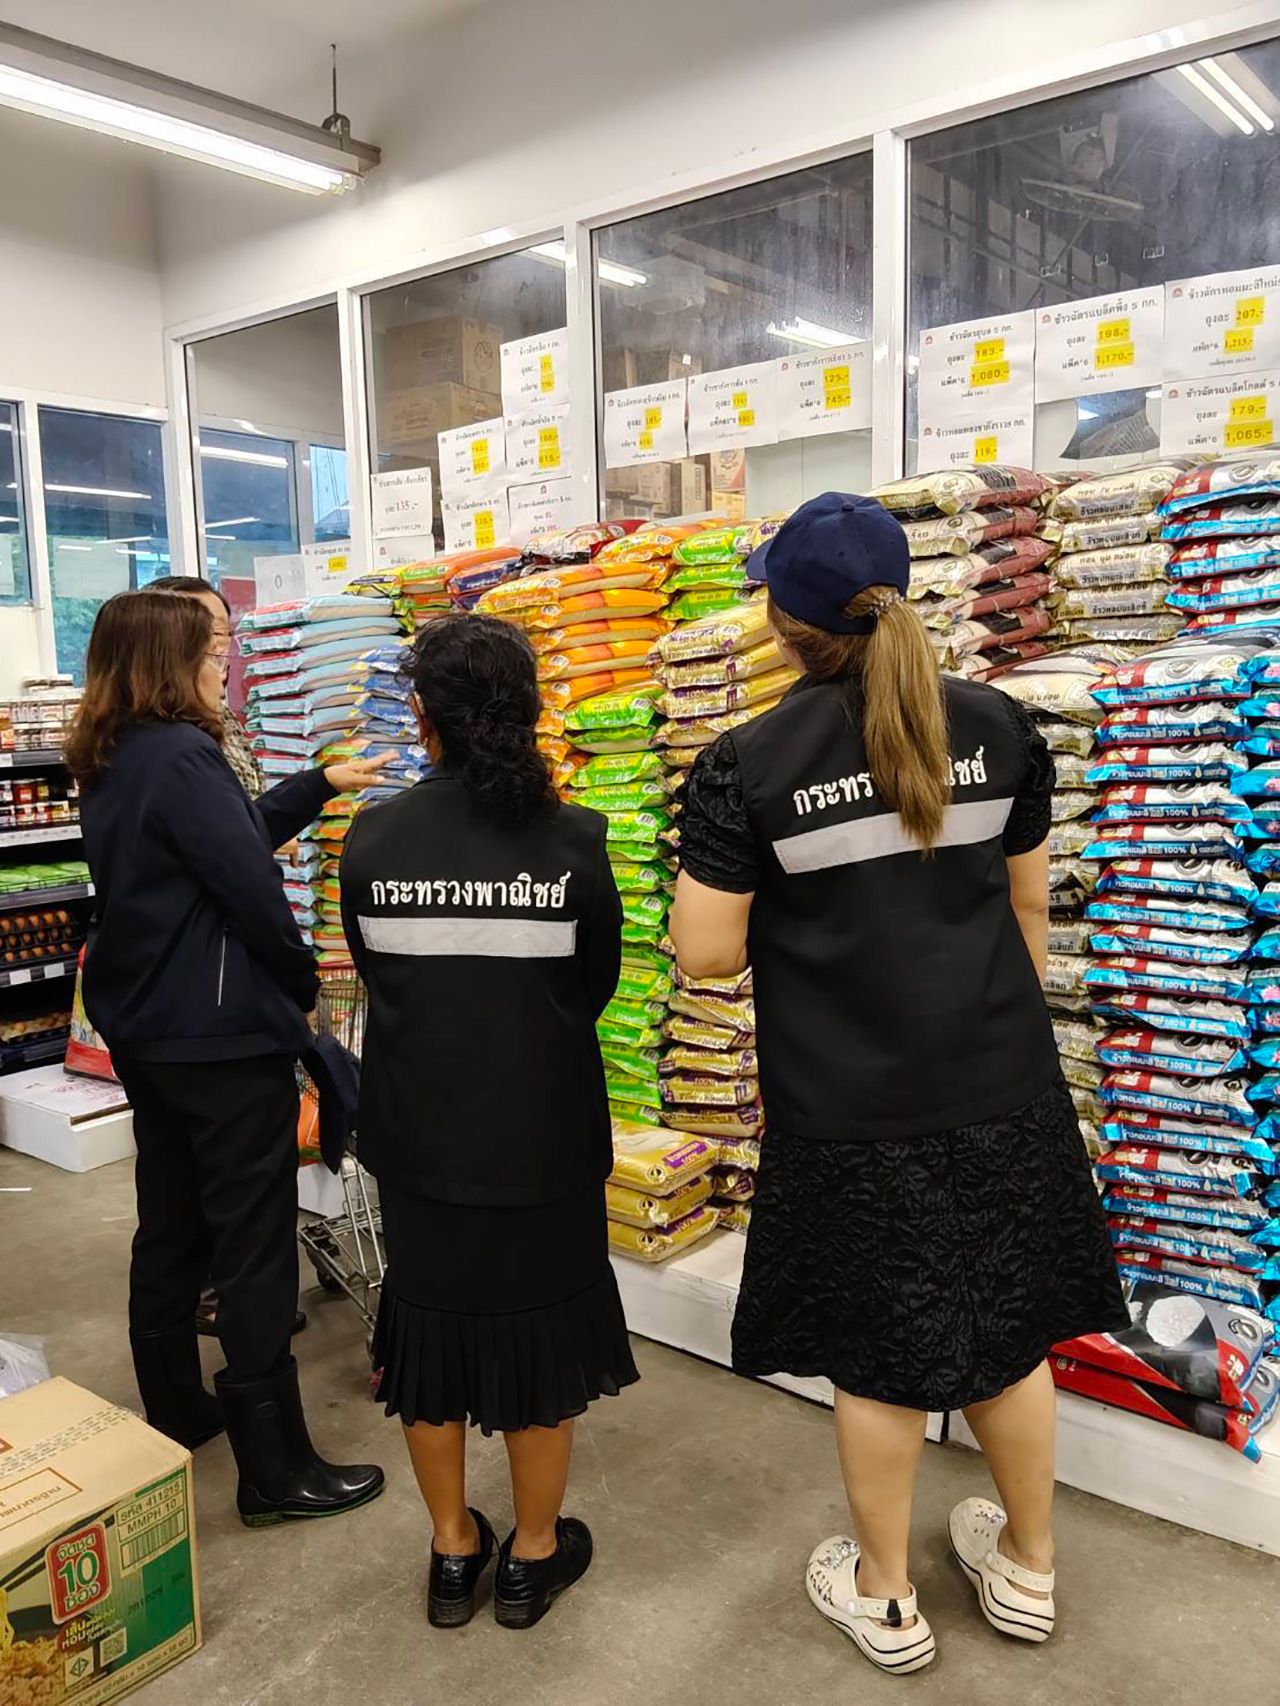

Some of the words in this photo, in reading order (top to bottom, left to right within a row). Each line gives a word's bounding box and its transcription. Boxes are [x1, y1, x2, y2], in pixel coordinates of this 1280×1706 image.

[1131, 301, 1138, 311] 5
[1141, 297, 1158, 309] กก.
[976, 347, 1004, 359] 183.-
[971, 368, 1010, 383] 1,080.-
[1231, 404, 1266, 416] 179.-
[1226, 428, 1272, 443] 1,065.-
[1168, 729, 1190, 737] 100%
[1169, 769, 1191, 777] 100%
[1166, 808, 1188, 817] 100%
[1164, 846, 1186, 854] 100%
[371, 870, 571, 908] กระทรวงพาณิชย์
[1171, 883, 1193, 893] 100%
[1169, 948, 1190, 957] 100%
[1165, 980, 1187, 990] 100%
[1170, 1060, 1192, 1070] 100%
[1169, 1101, 1191, 1113] 100%
[1180, 1137, 1202, 1148] 100%
[1178, 1179, 1200, 1189] 100%
[1180, 1280, 1203, 1292] 100%
[121, 1503, 144, 1521] รหัส
[127, 1508, 161, 1535] MMPH
[165, 1498, 177, 1514] 10
[58, 1550, 99, 1596] 10
